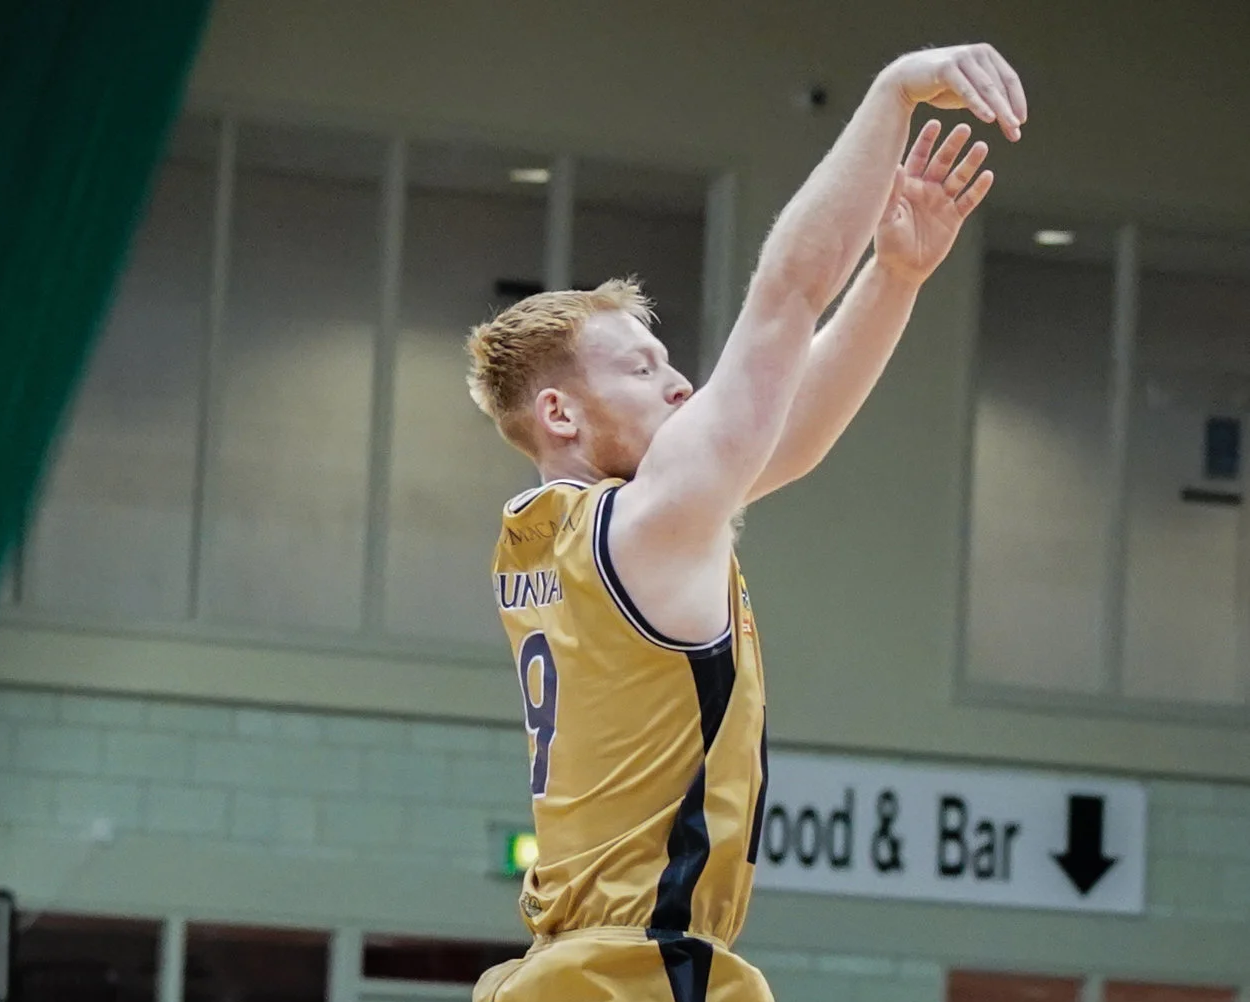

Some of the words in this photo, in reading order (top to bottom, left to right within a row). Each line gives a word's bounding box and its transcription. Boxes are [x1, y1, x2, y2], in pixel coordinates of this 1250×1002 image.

[518, 629, 558, 799] 9
[763, 787, 854, 870] ood
[871, 790, 904, 873] &
[937, 793, 1021, 882] Bar
